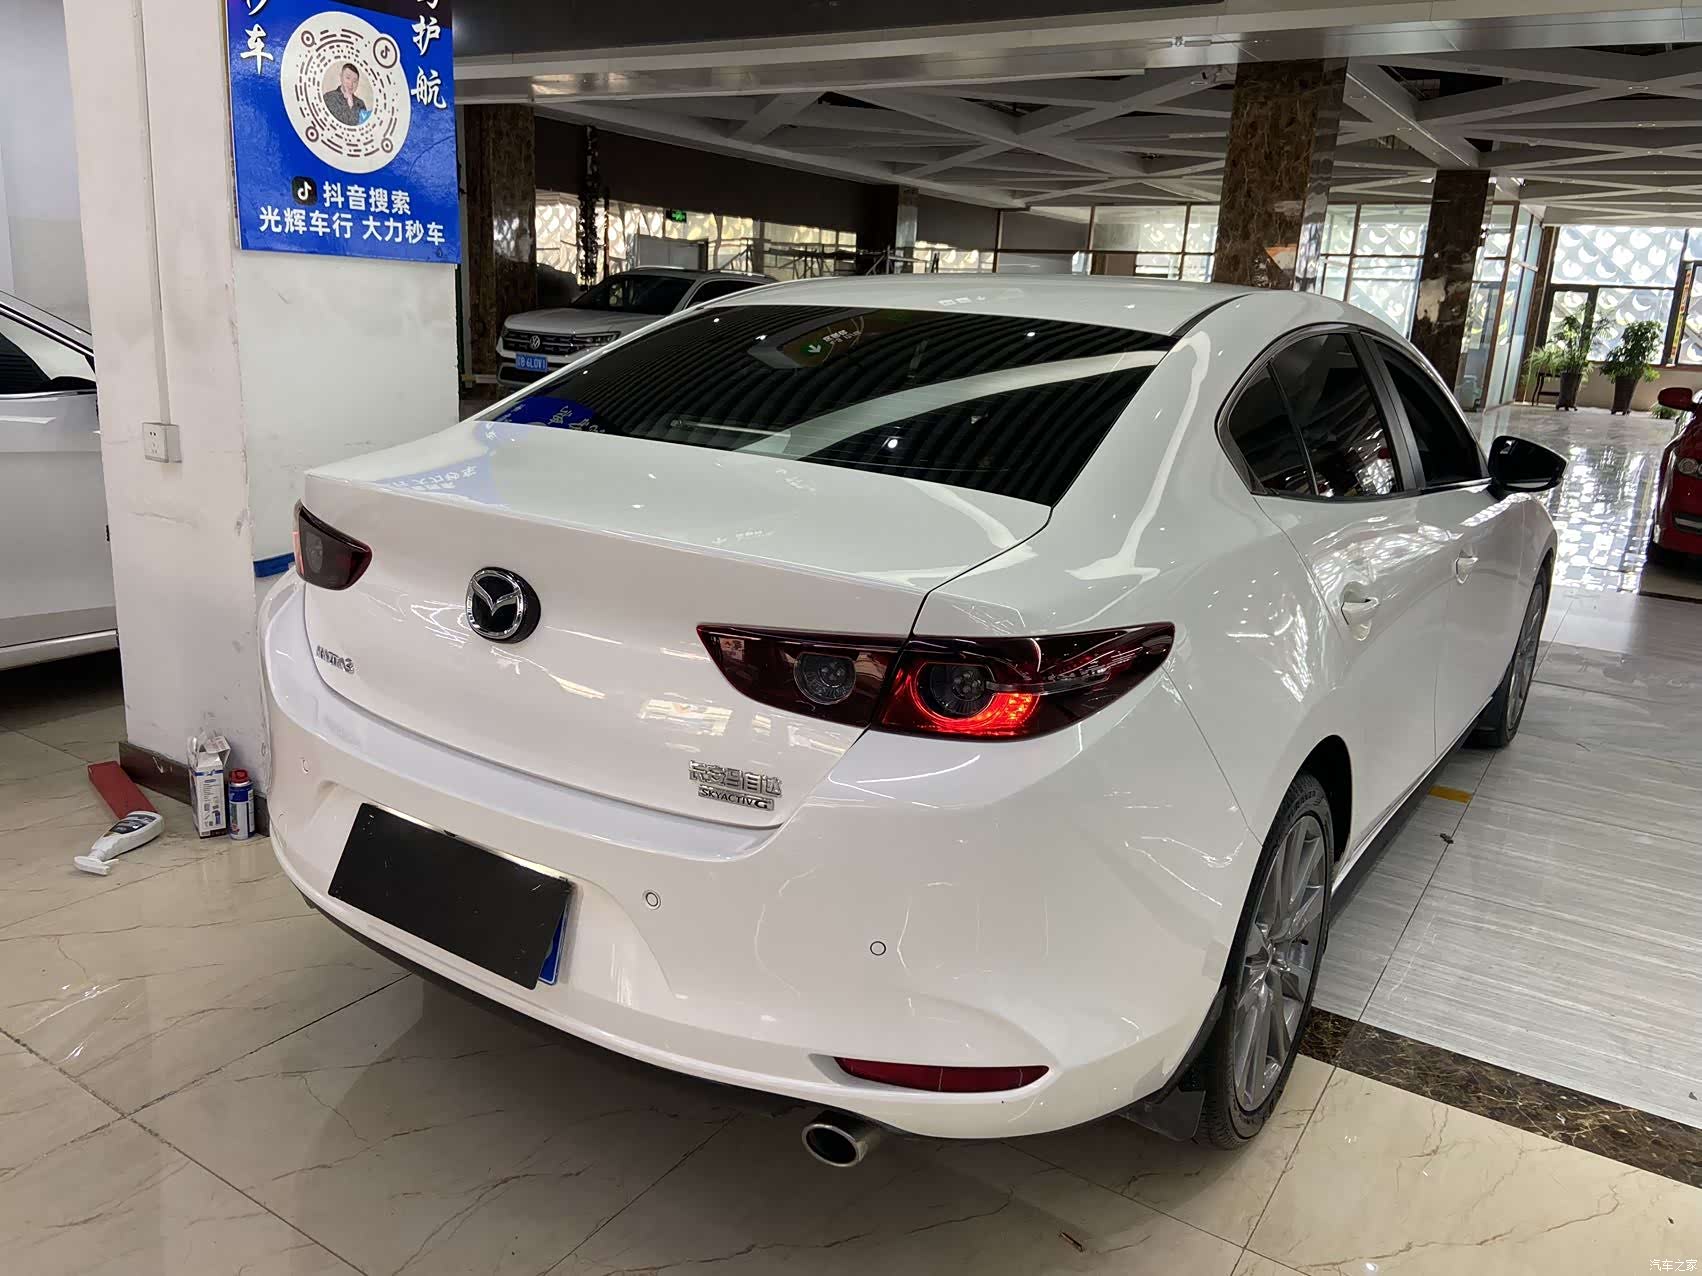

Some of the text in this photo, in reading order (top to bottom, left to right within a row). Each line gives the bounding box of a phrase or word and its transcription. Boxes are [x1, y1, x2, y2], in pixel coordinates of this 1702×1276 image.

[410, 0, 447, 109] 护航
[323, 181, 411, 215] 抖音搜索
[259, 205, 445, 246] 光辉车行 大力秒车
